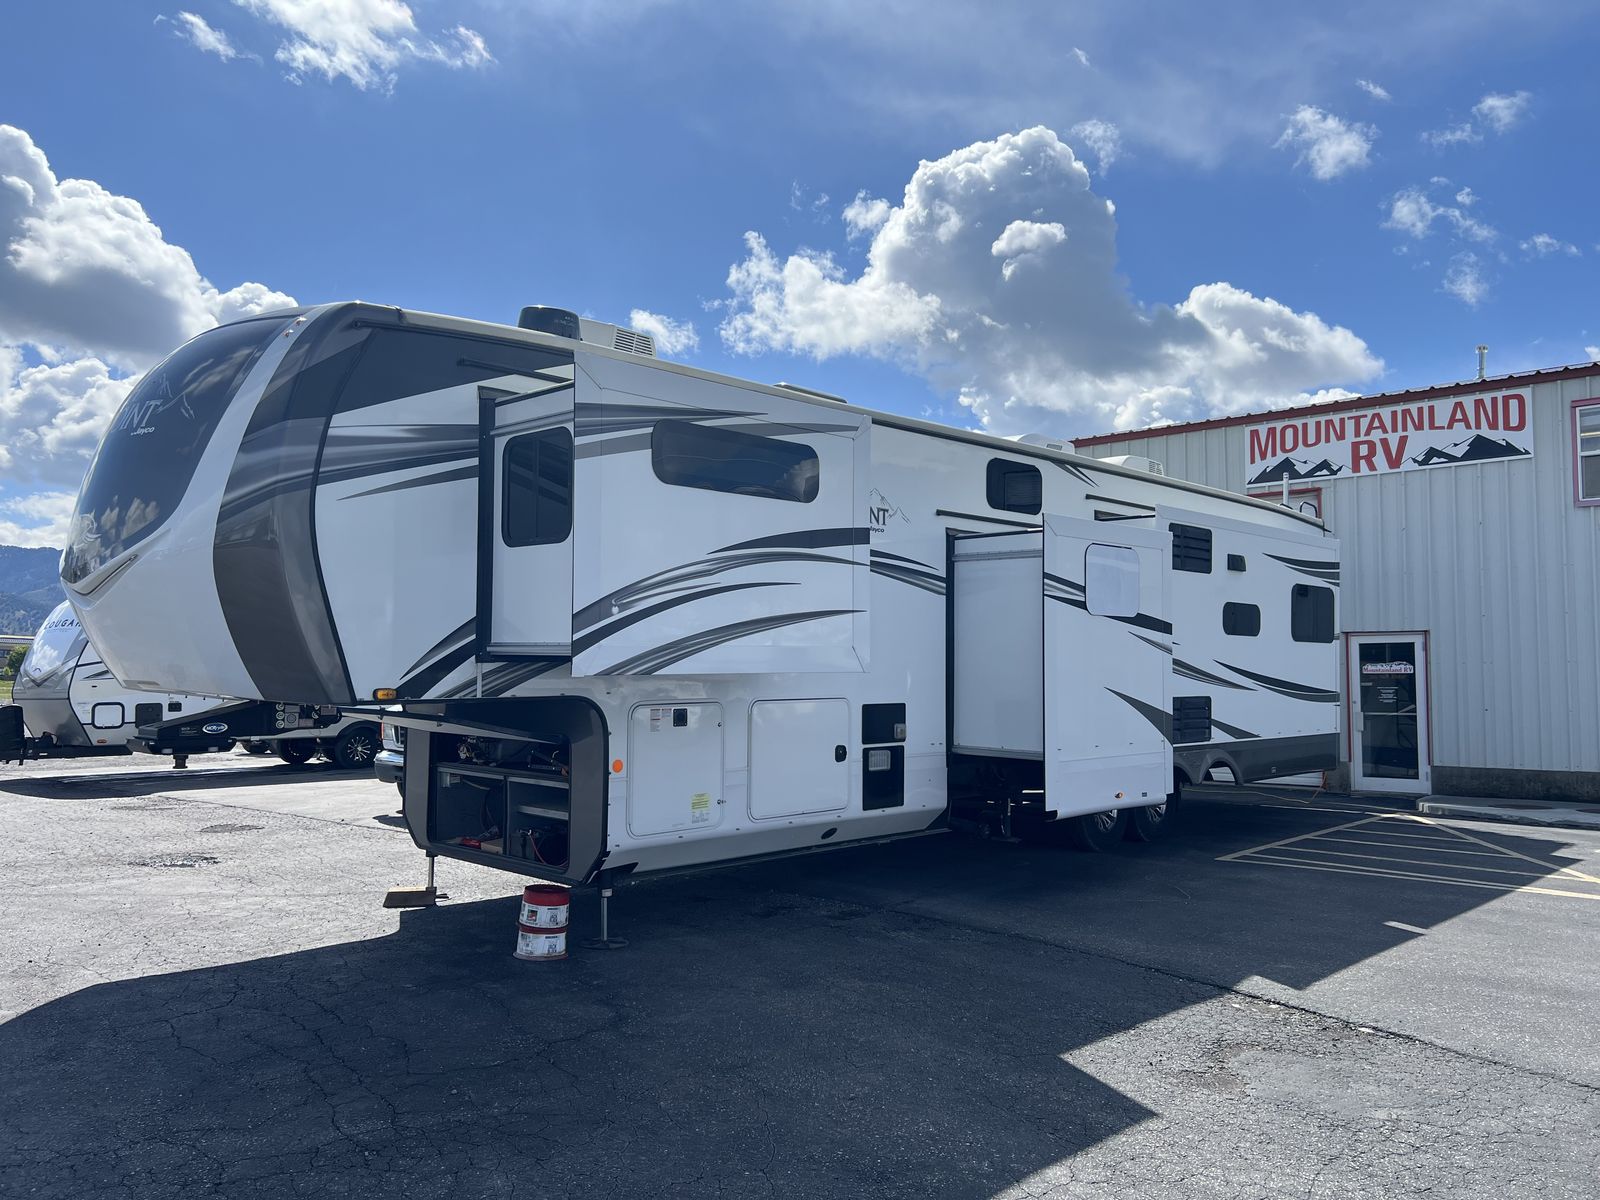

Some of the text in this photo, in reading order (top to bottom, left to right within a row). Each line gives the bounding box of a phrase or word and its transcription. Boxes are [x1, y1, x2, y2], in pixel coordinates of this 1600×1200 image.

[131, 426, 155, 436] Jayco
[1249, 393, 1527, 465] MOUNTAINLAND
[1351, 435, 1409, 474] RV
